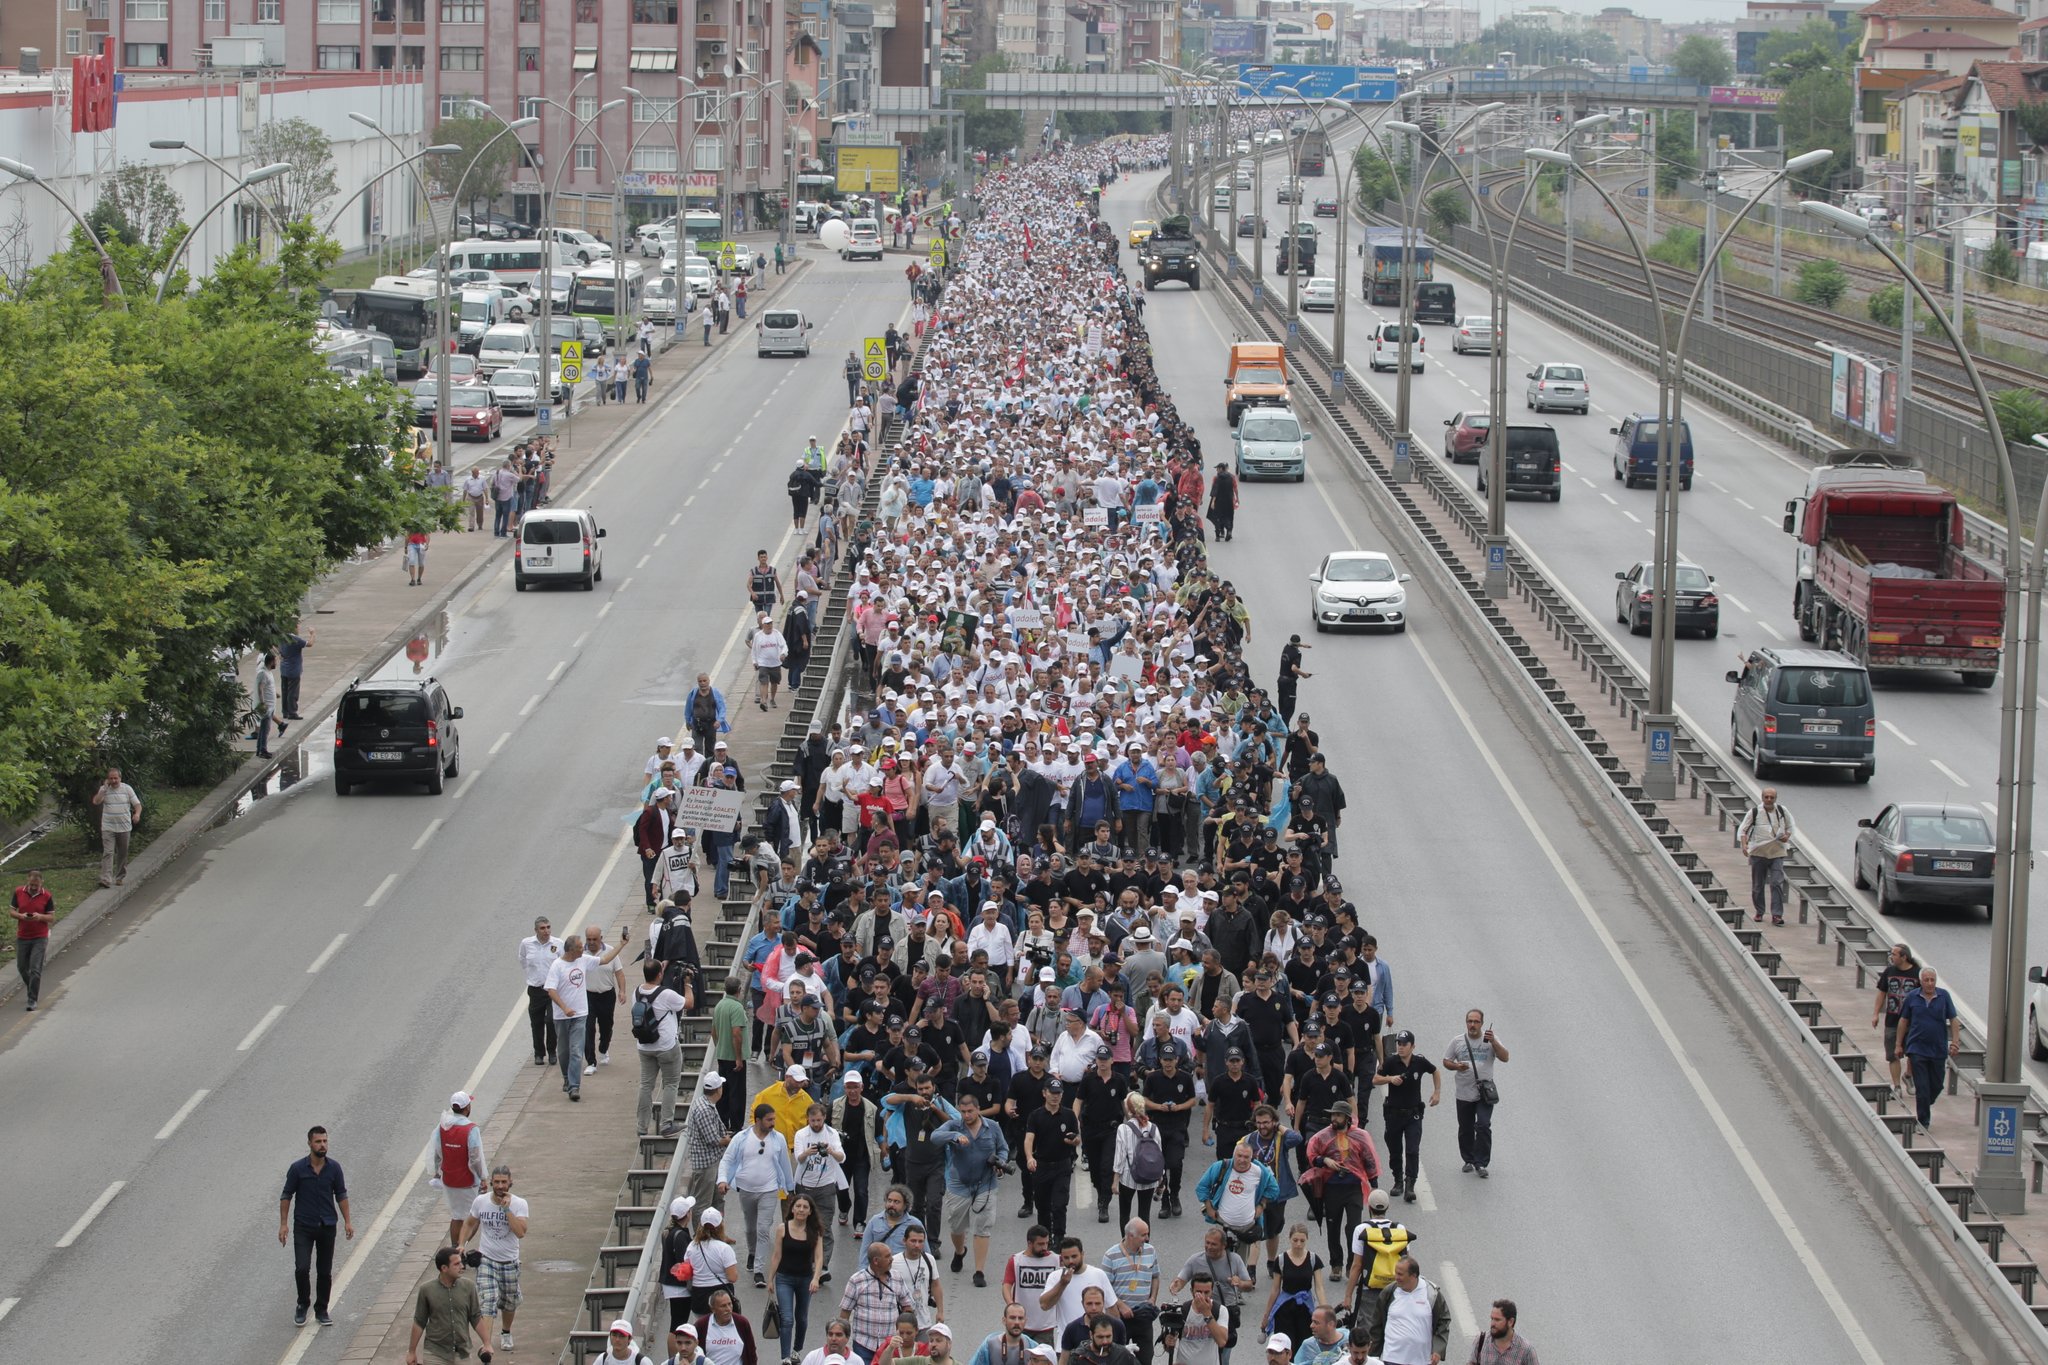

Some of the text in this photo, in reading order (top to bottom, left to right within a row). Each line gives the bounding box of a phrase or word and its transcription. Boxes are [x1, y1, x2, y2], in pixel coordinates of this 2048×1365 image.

[566, 369, 577, 377] 30
[870, 366, 880, 375] 30
[1137, 512, 1159, 520] adalet
[1015, 614, 1039, 623] adalet
[1067, 639, 1088, 649] adalet
[479, 1211, 509, 1221] HILFIGE
[711, 1337, 737, 1345] adalet
